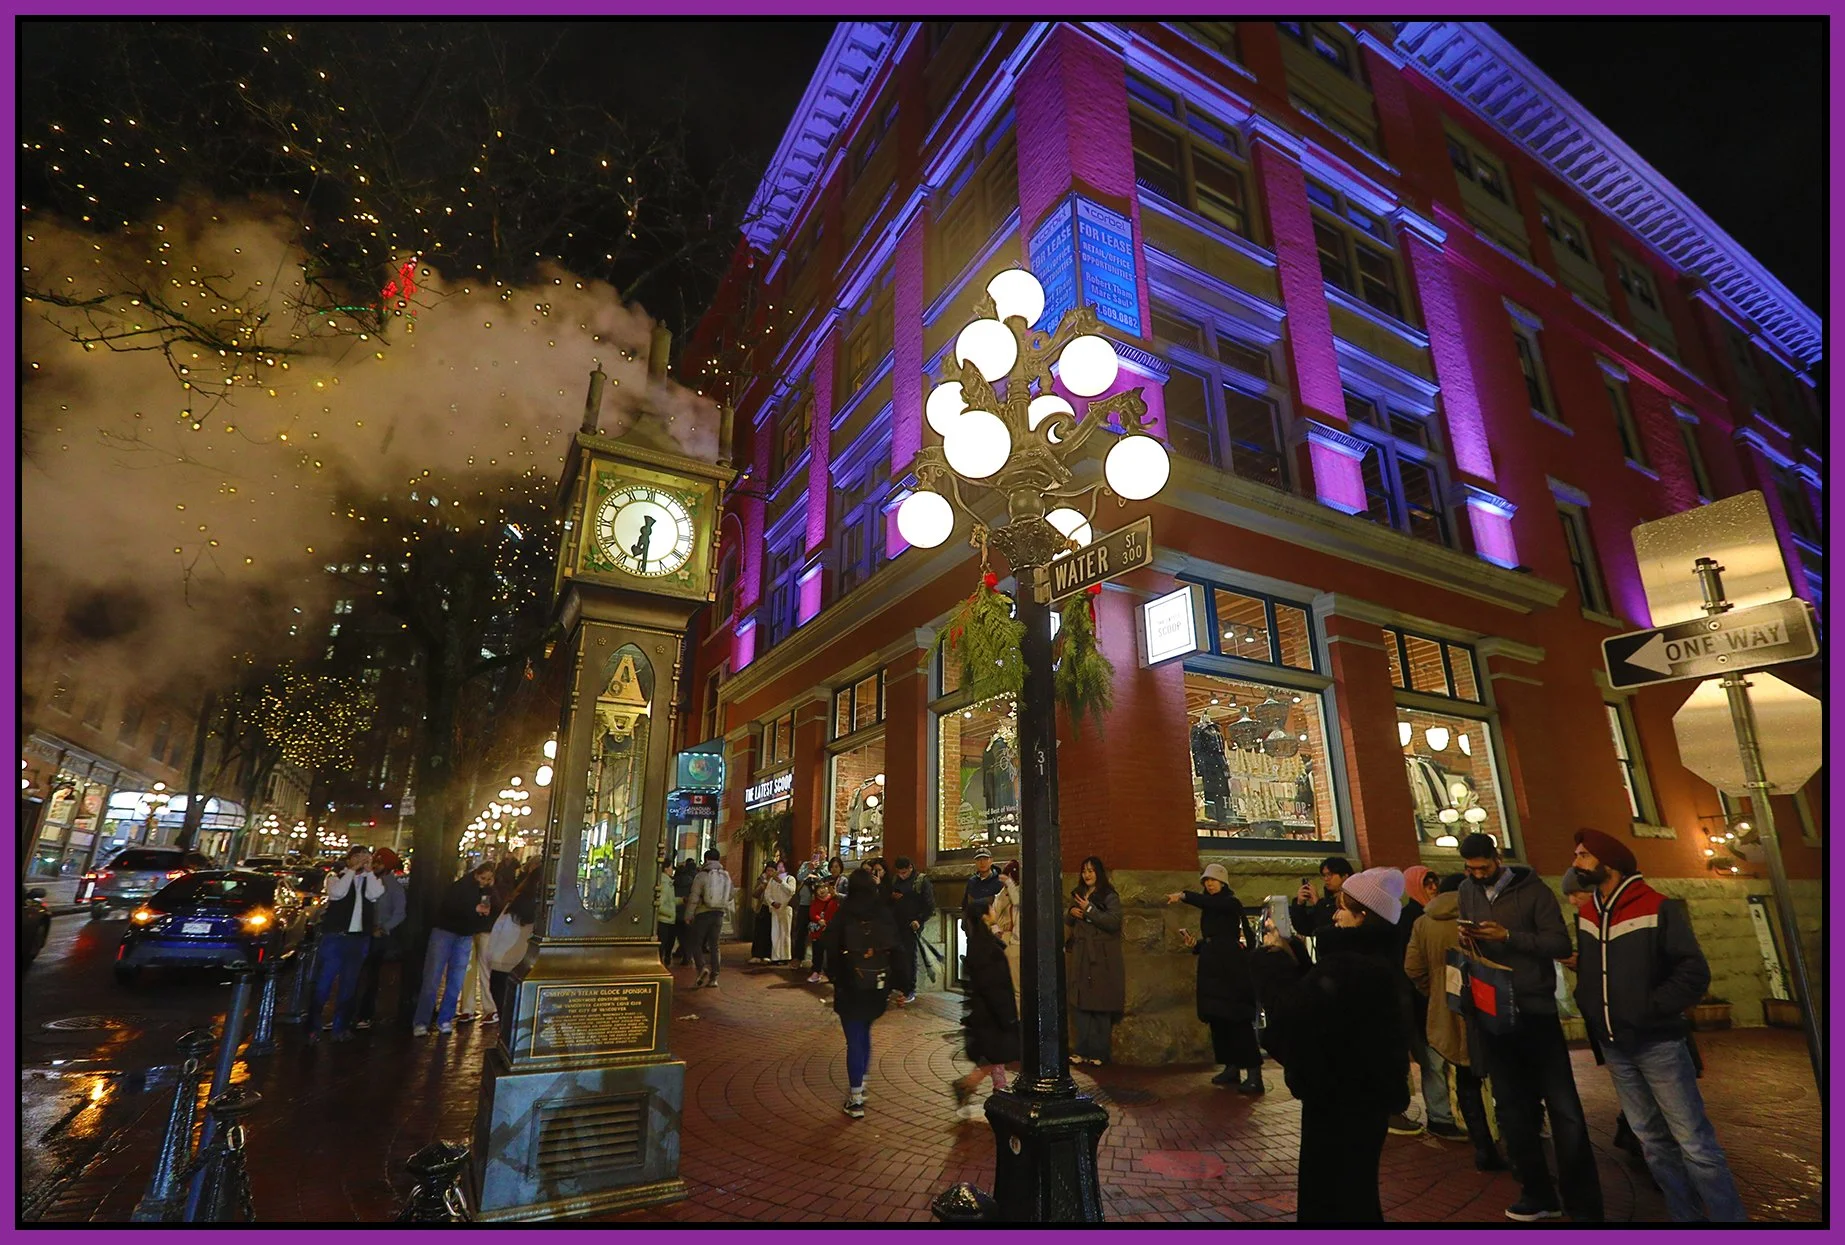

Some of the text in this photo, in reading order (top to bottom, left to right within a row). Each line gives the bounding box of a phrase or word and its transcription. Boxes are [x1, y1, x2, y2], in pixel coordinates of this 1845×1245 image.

[1091, 209, 1125, 231] corbel
[1031, 223, 1072, 275] FOR LEASE
[1079, 221, 1133, 256] FOR LEASE
[1082, 241, 1131, 269] RETAIL/OFFICE
[1082, 252, 1134, 281] OPPORTUNITIES
[1086, 271, 1133, 300] Robert Tham
[1091, 284, 1112, 301] Marc
[1125, 532, 1136, 548] ST
[1055, 545, 1142, 592] WATER 300
[1158, 620, 1182, 637] SCOOP
[1665, 623, 1780, 661] ONE WAY
[754, 780, 774, 801] LATEST
[774, 773, 793, 794] SCOOP
[622, 987, 652, 995] SPONSORS
